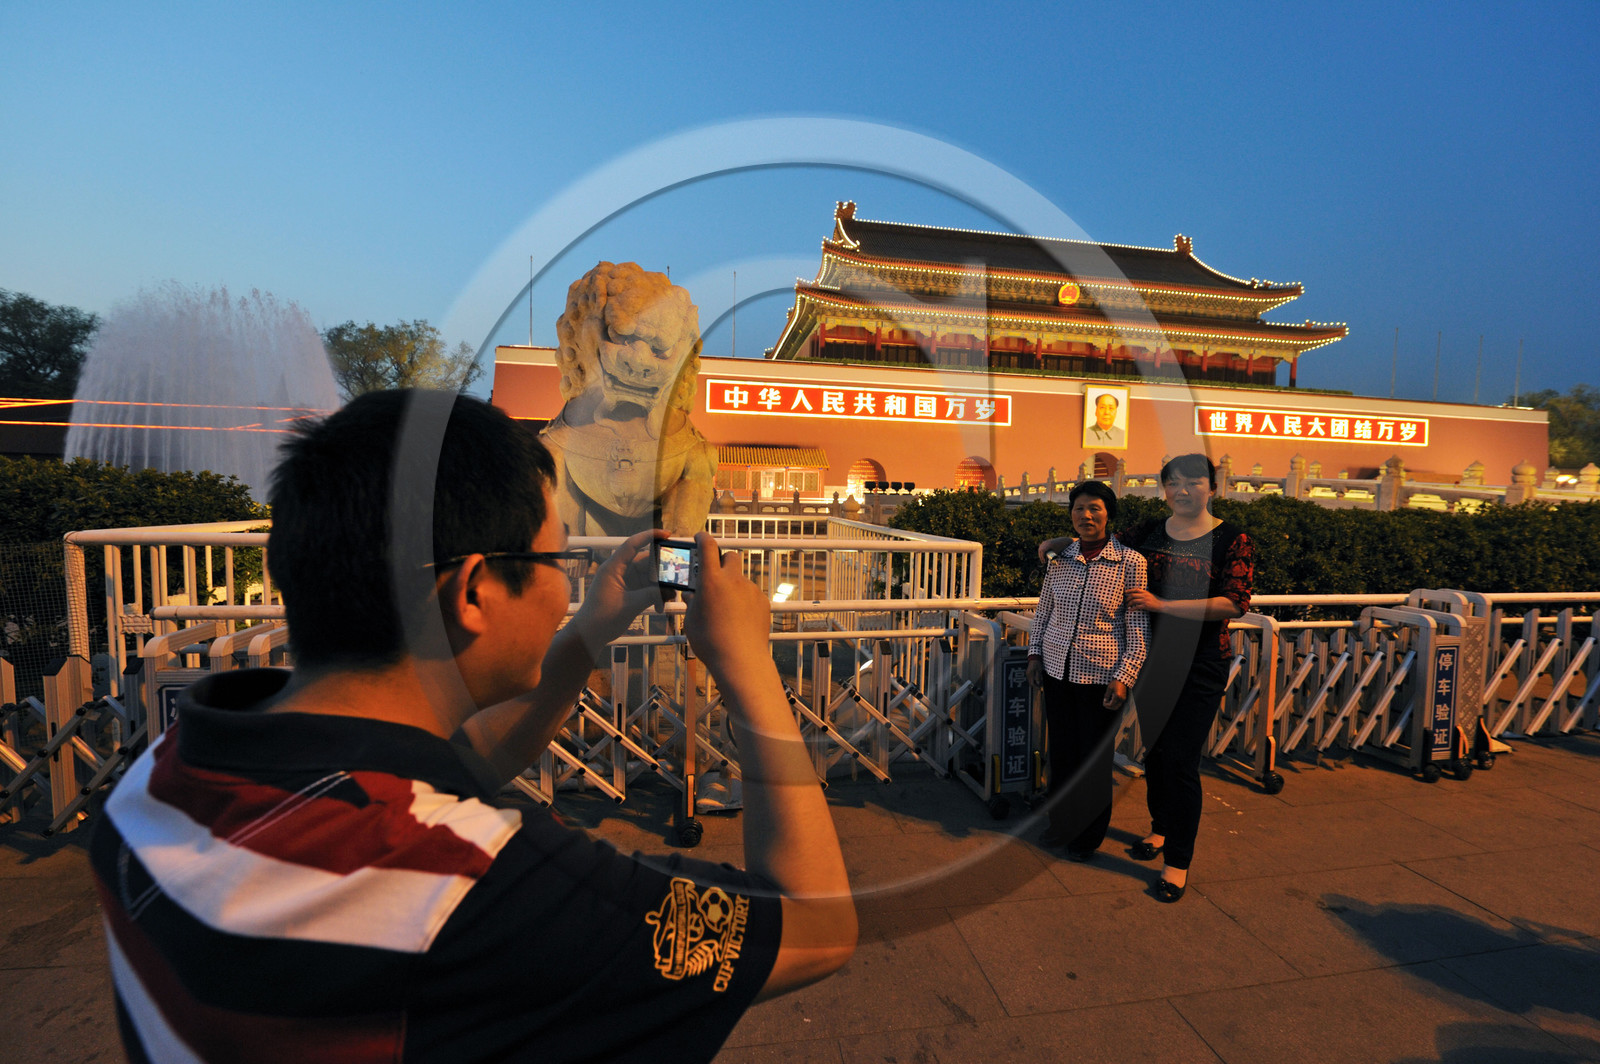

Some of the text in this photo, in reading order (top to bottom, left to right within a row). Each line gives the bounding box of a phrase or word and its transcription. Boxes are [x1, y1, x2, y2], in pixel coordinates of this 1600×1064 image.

[724, 386, 996, 420] 中华人民共和国万岁
[1209, 411, 1418, 442] 世界人民大团结万岁
[1007, 667, 1027, 775] 停车验证
[1434, 652, 1453, 745] 停车验证
[713, 894, 750, 992] CUP VICTORY
